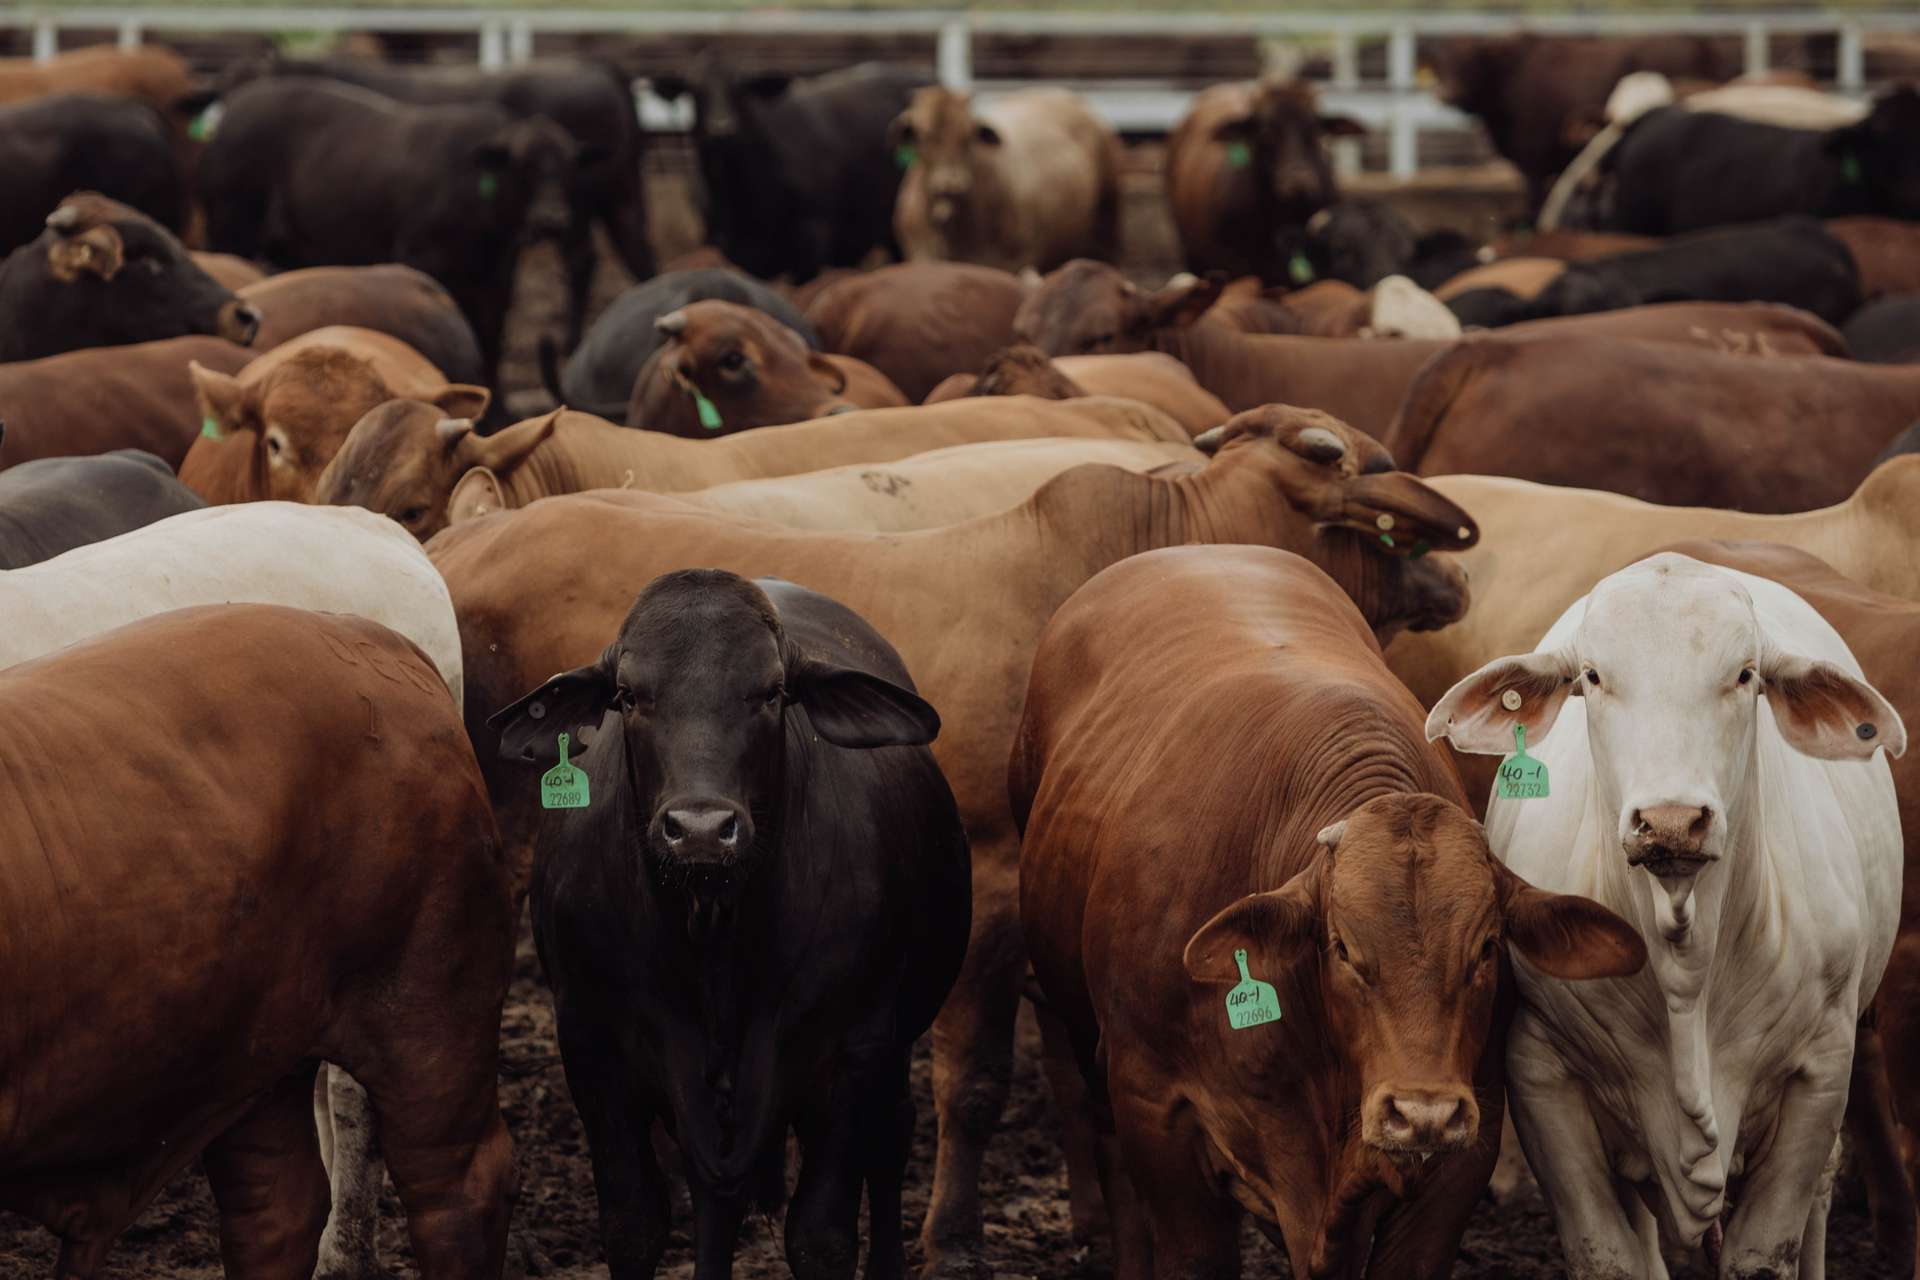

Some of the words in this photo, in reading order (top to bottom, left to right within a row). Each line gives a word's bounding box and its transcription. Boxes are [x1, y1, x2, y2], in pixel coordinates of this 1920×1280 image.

[550, 792, 582, 806] 22689
[1229, 985, 1261, 1007] 40-1
[1236, 1005, 1273, 1027] 22696
